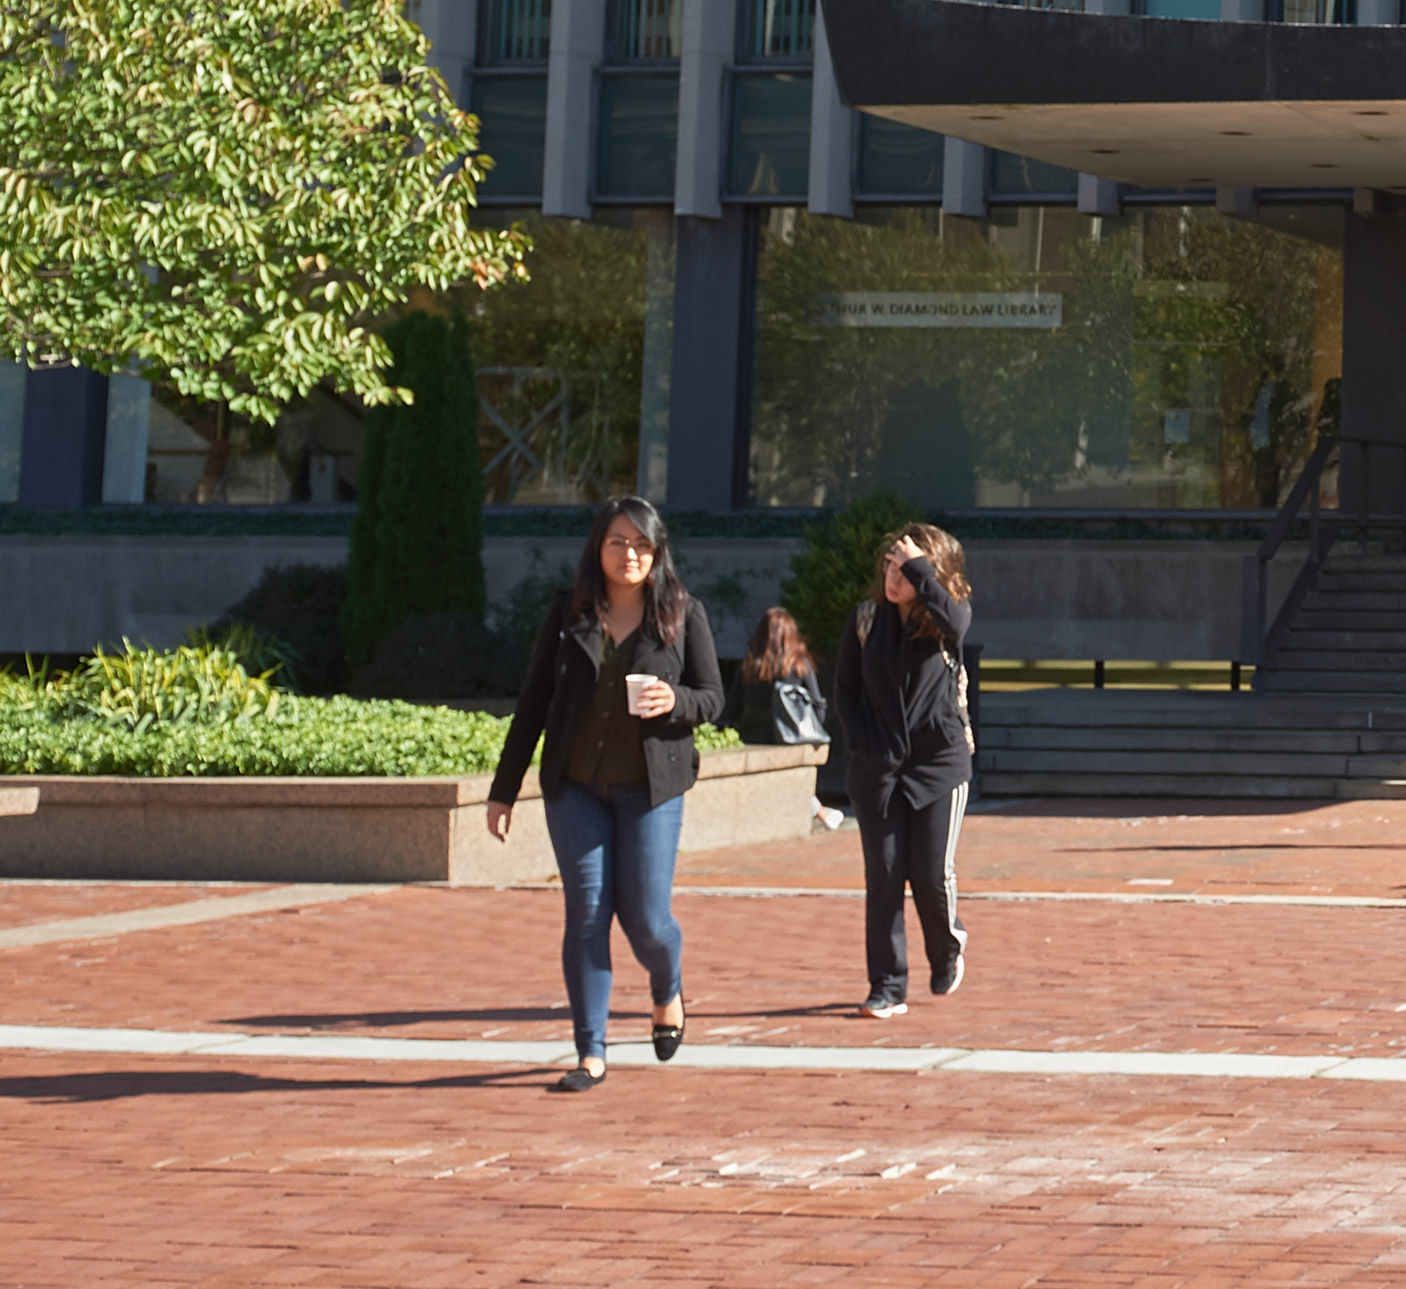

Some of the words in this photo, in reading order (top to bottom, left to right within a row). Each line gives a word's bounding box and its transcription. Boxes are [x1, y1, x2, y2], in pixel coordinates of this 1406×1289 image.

[810, 302, 867, 315] RTHUR
[889, 302, 959, 316] DIAMOND
[962, 303, 994, 316] LAW
[997, 303, 1057, 316] LIBRARY
